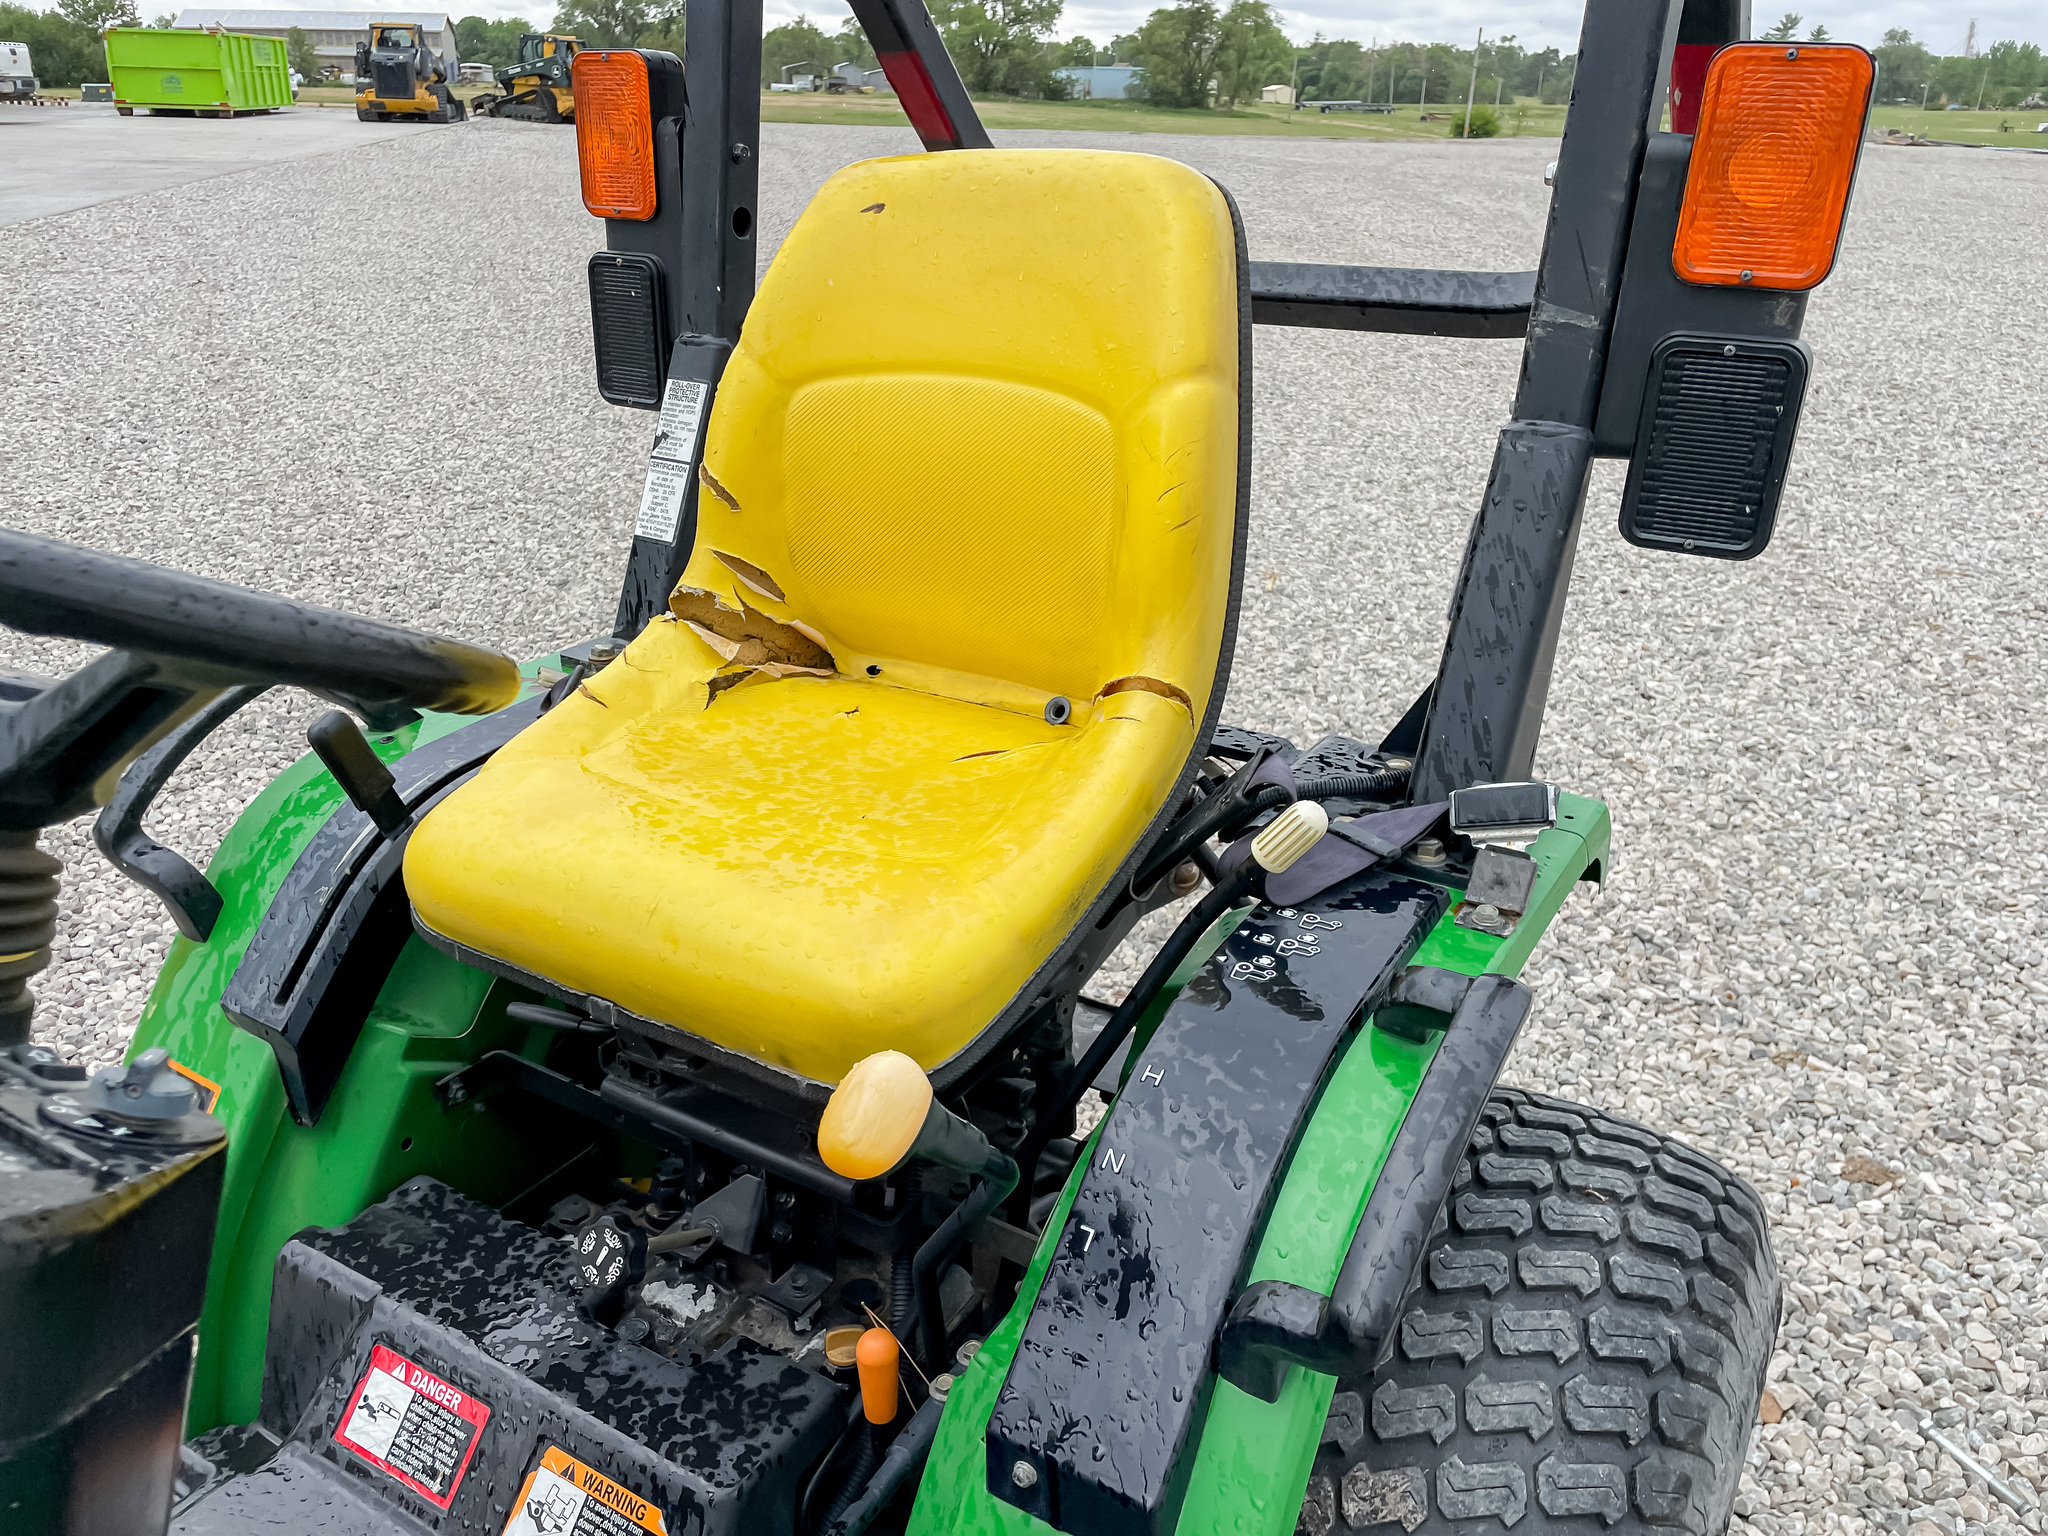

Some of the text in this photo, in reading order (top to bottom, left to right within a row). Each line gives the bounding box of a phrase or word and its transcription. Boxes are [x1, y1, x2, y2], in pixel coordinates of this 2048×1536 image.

[669, 387, 700, 397] PROTECTIVE
[671, 381, 700, 390] ROLL-OVER
[668, 394, 698, 404] STRUCTURE
[650, 461, 687, 473] CERTIFICATION
[1102, 1148, 1126, 1174] N
[581, 1230, 597, 1254] OPEN
[604, 1228, 622, 1249] SLOW
[582, 1265, 599, 1285] FAST
[605, 1257, 623, 1285] CLOSE
[410, 1370, 462, 1411] DANGER
[414, 1393, 462, 1426] To avoid injury to
[406, 1411, 455, 1445] when children are
[446, 1424, 467, 1440] mower
[391, 1446, 406, 1459] carry
[426, 1435, 438, 1444] not
[436, 1440, 453, 1454] mow
[451, 1448, 458, 1458] in
[387, 1454, 414, 1476] especially
[410, 1446, 433, 1466] backing.
[434, 1460, 452, 1476] Never
[434, 1449, 456, 1467] behind
[583, 1470, 647, 1521] WARNING
[578, 1518, 594, 1533] down
[586, 1496, 594, 1508] To
[594, 1503, 612, 1517] avoid
[628, 1521, 644, 1535] from
